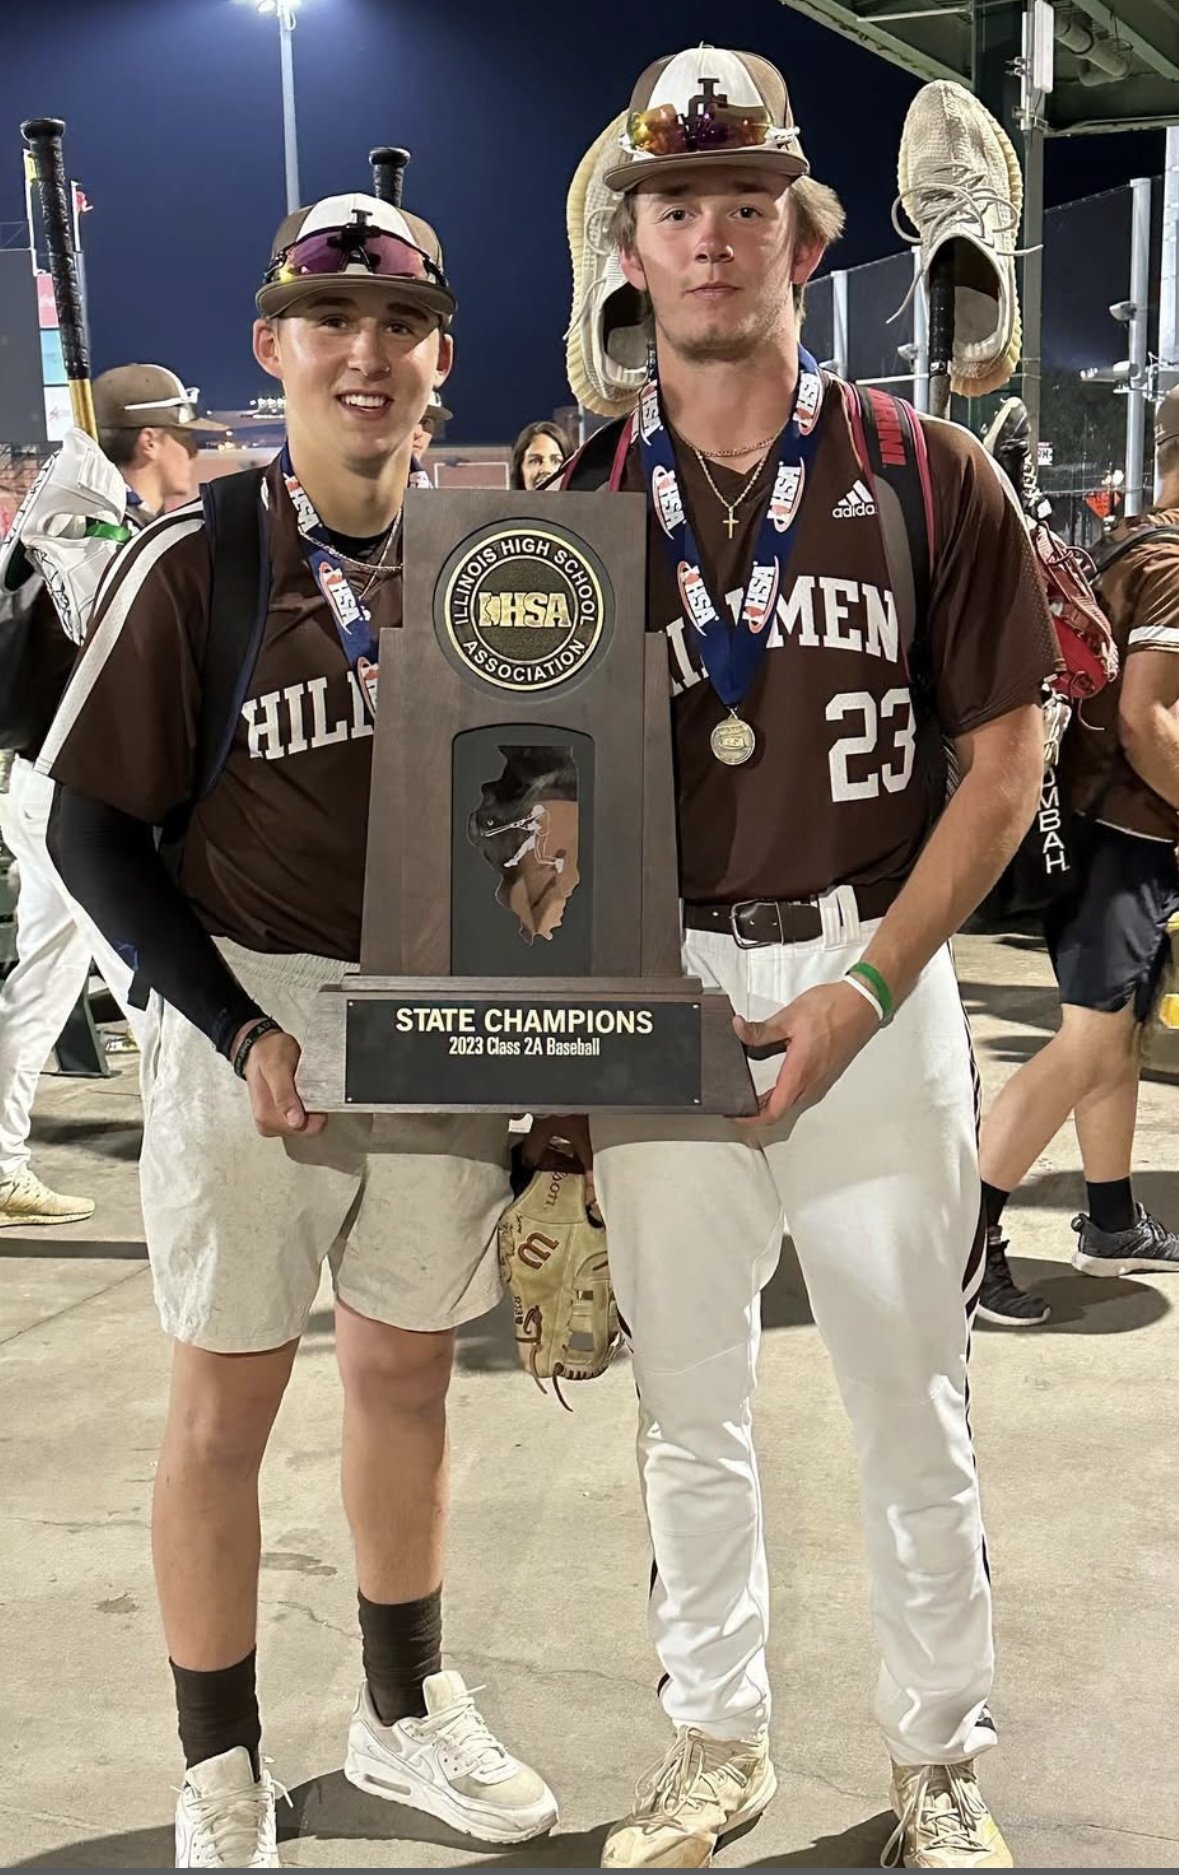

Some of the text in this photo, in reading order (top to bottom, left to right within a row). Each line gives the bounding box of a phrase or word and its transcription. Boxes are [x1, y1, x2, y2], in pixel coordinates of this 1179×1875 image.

[832, 502, 877, 518] adida
[453, 538, 596, 626] ILLINOIS HIGH SCHOOL
[478, 591, 572, 628] IHSA
[462, 638, 586, 682] ASSOCIATION
[825, 688, 917, 803] 23
[396, 1007, 654, 1034] STATE CHAMPIONS
[449, 1036, 600, 1056] 2023 Class 2A Baseball
